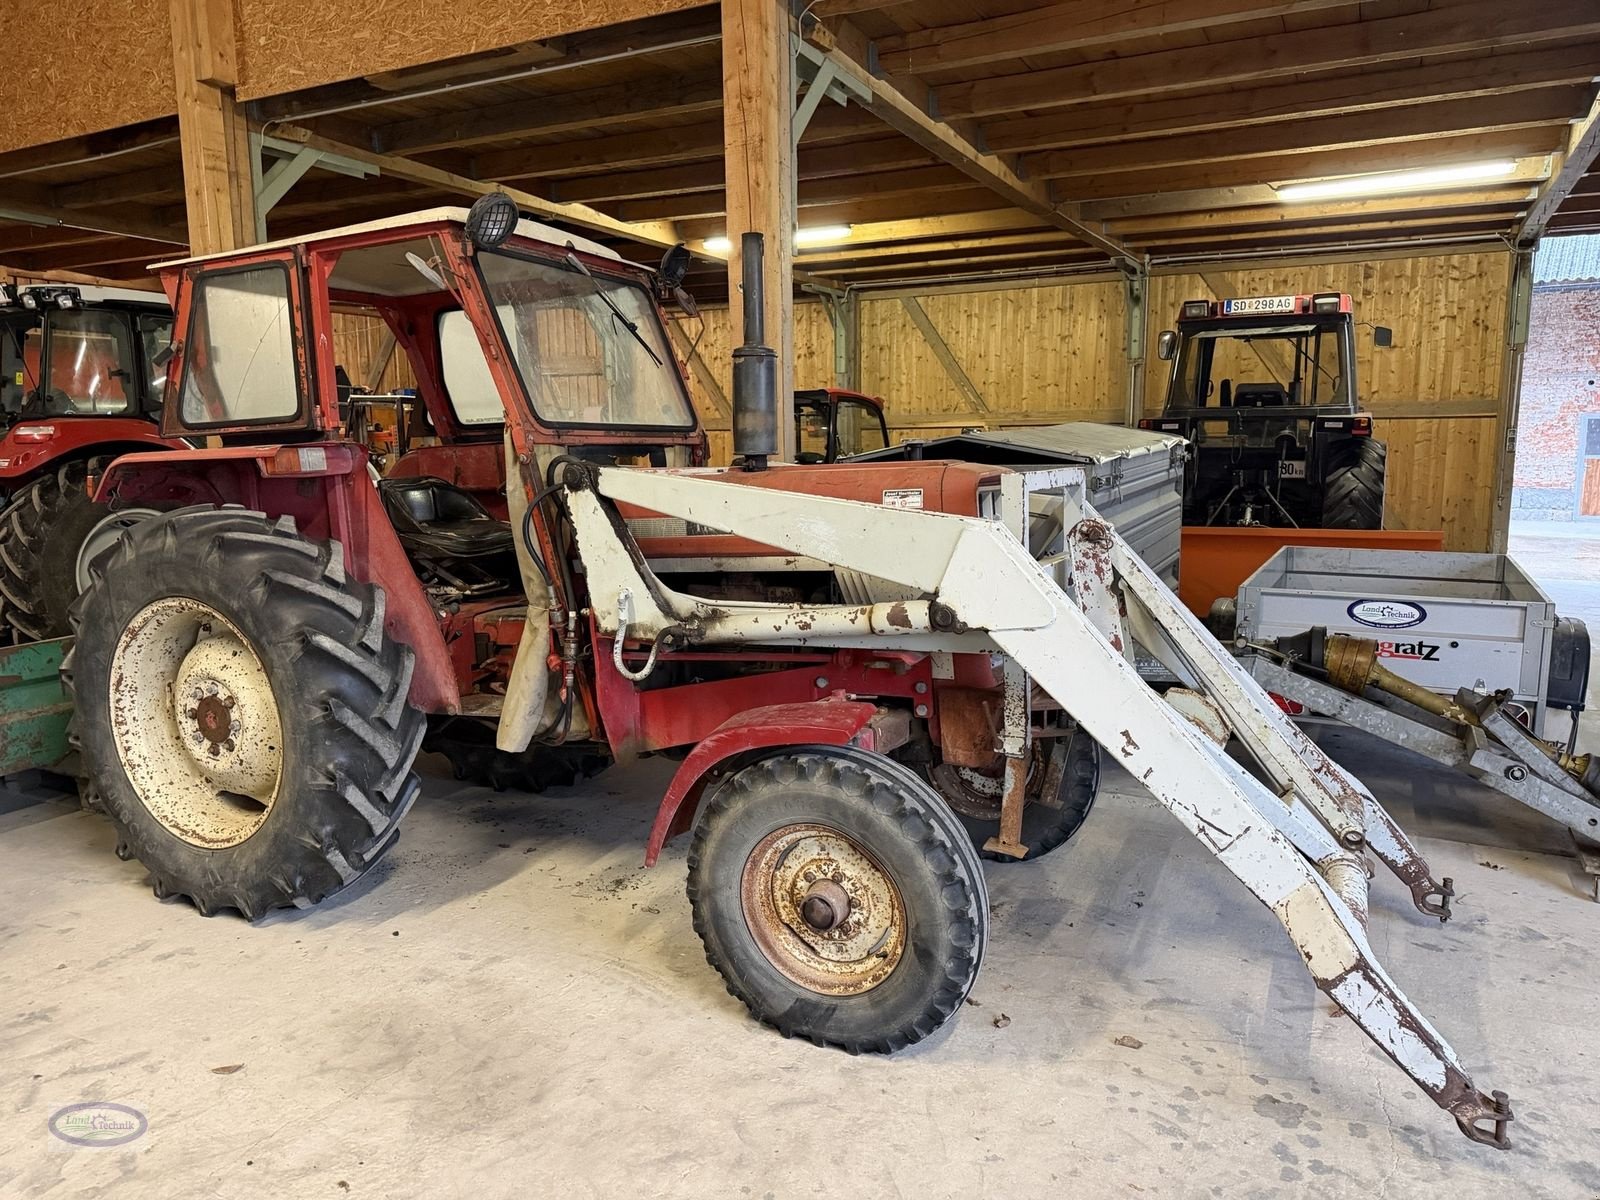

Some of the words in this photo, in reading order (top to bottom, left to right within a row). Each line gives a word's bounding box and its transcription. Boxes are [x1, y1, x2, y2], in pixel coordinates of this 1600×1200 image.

[1233, 300, 1247, 311] SD
[1254, 299, 1275, 310] 298
[1276, 297, 1291, 308] AG
[1362, 605, 1381, 613] Land
[1386, 610, 1416, 619] Technik
